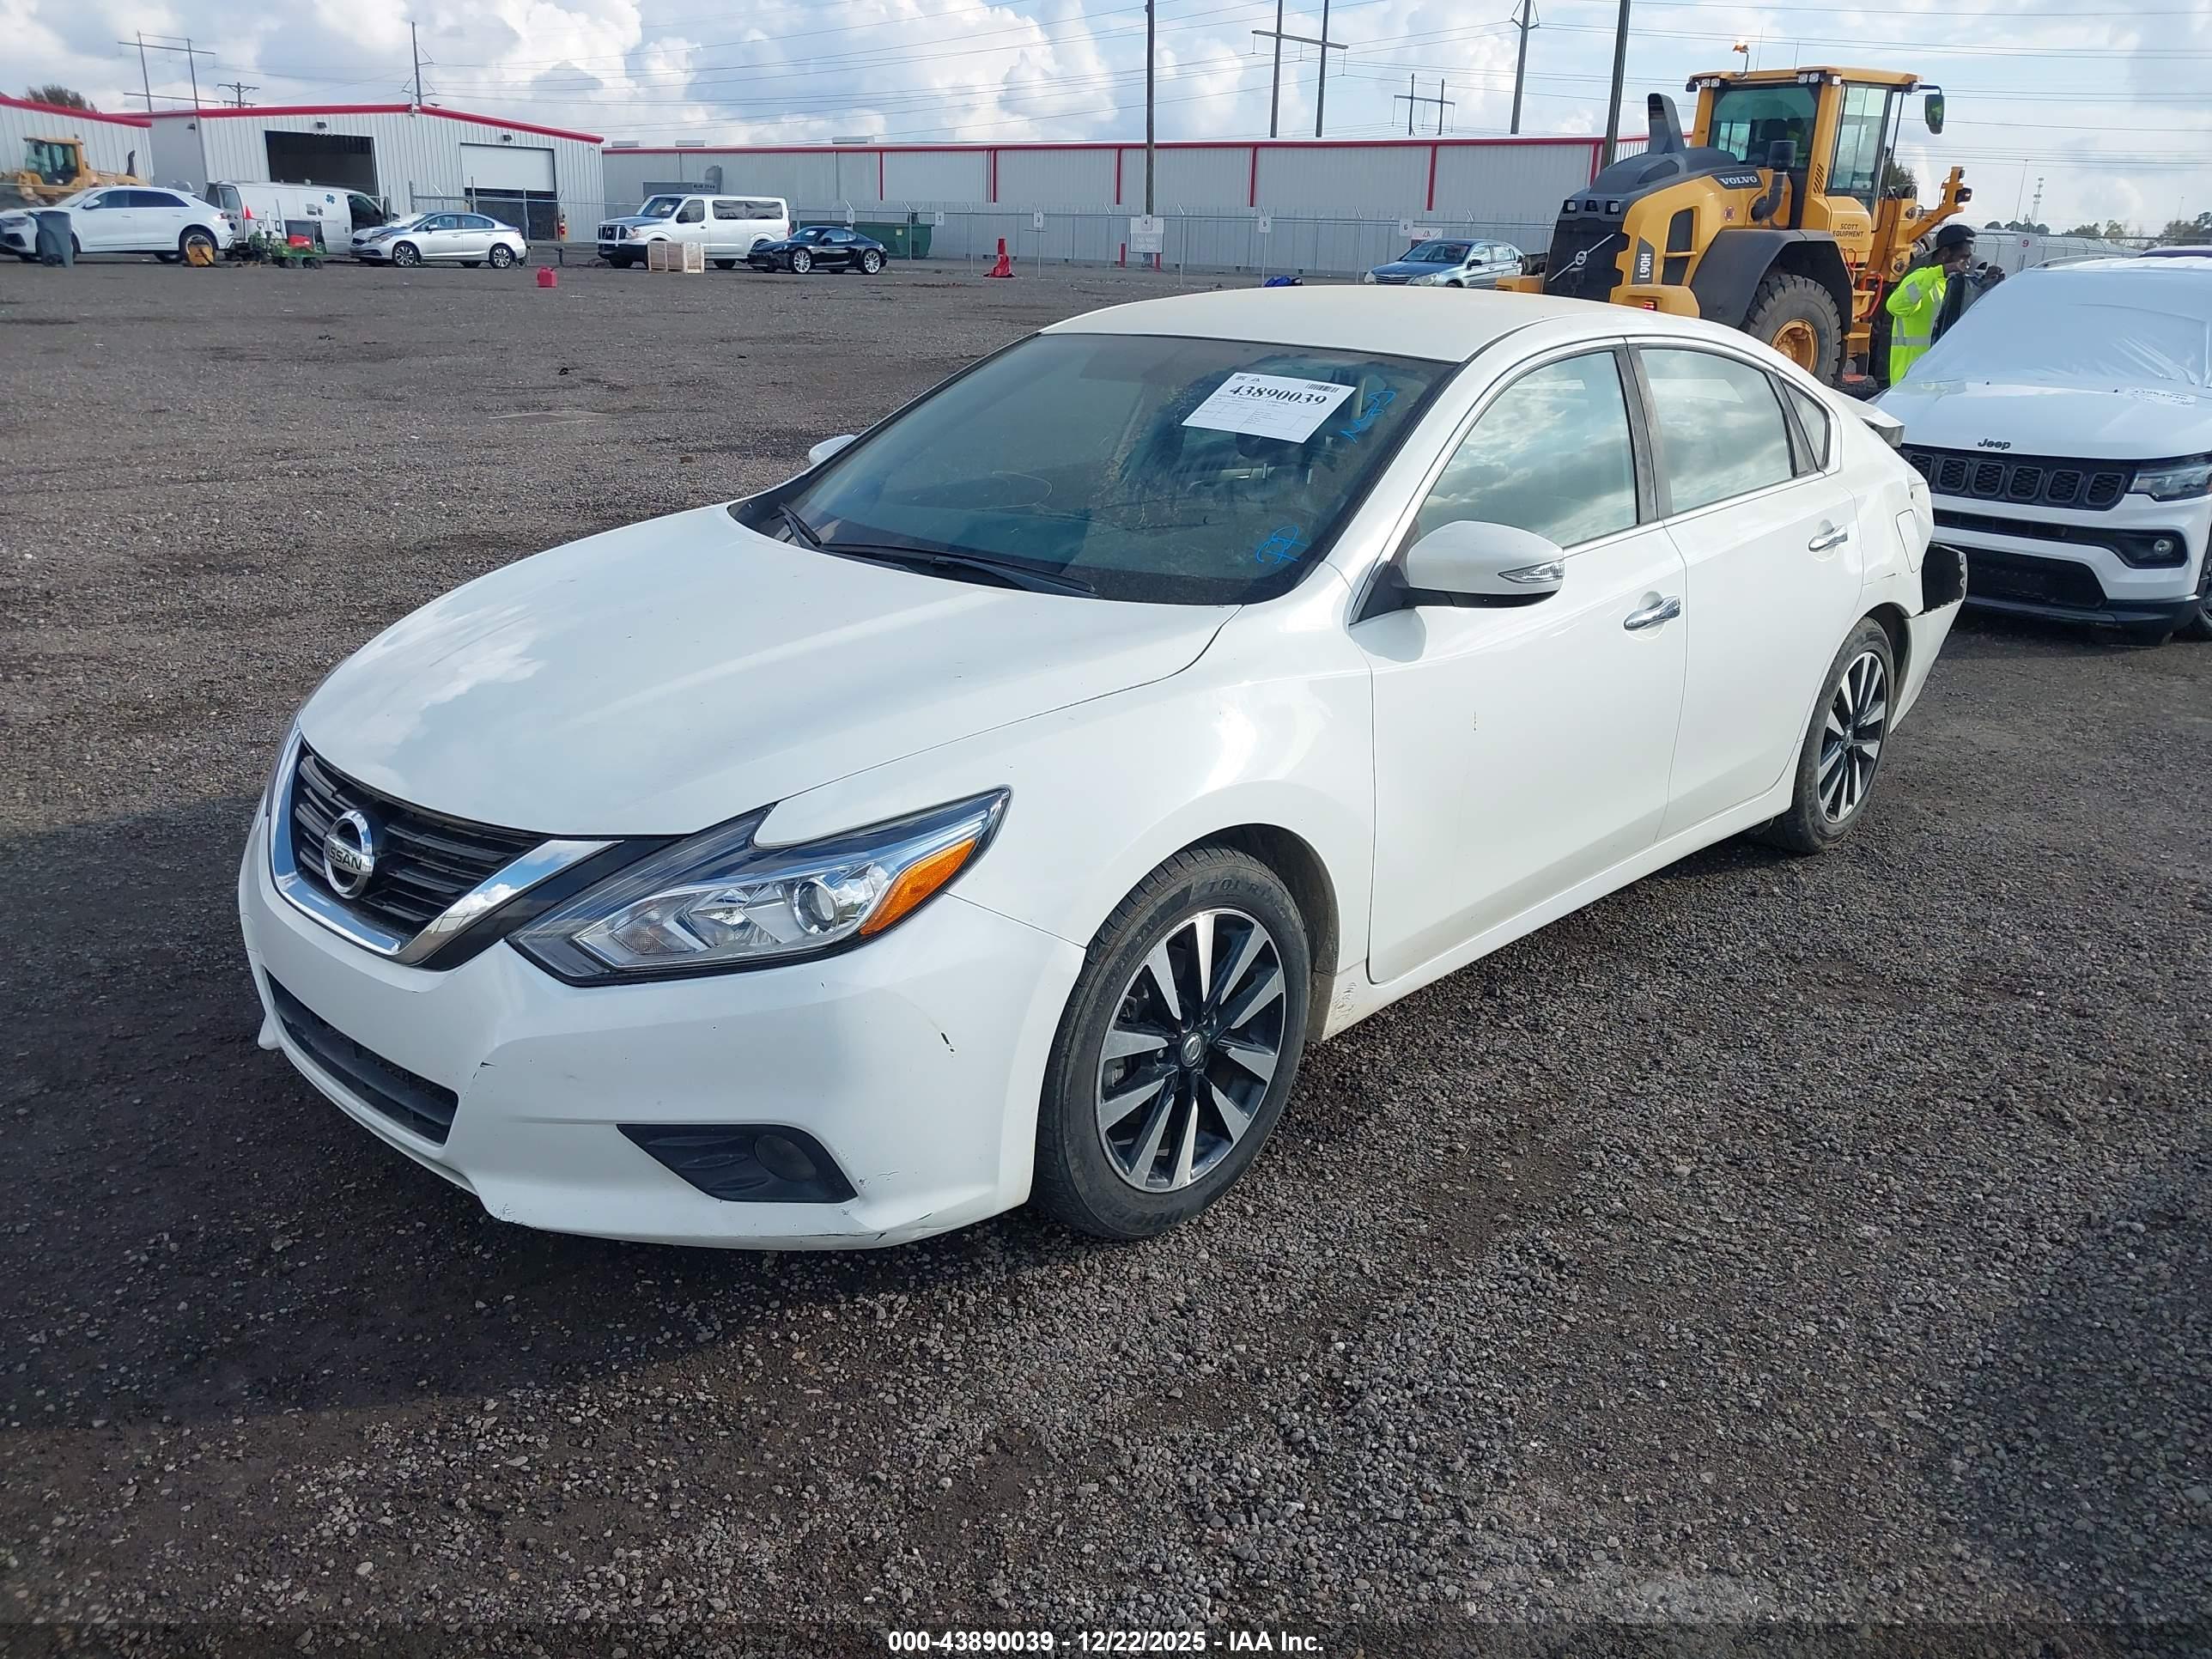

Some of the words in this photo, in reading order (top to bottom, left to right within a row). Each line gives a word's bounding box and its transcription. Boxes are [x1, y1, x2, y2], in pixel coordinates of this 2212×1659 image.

[1719, 175, 1758, 185] VOLVO
[2021, 239, 2029, 248] 9
[1639, 253, 1651, 279] L90H
[1230, 385, 1328, 406] 43890039
[1977, 438, 2011, 451] Jeep
